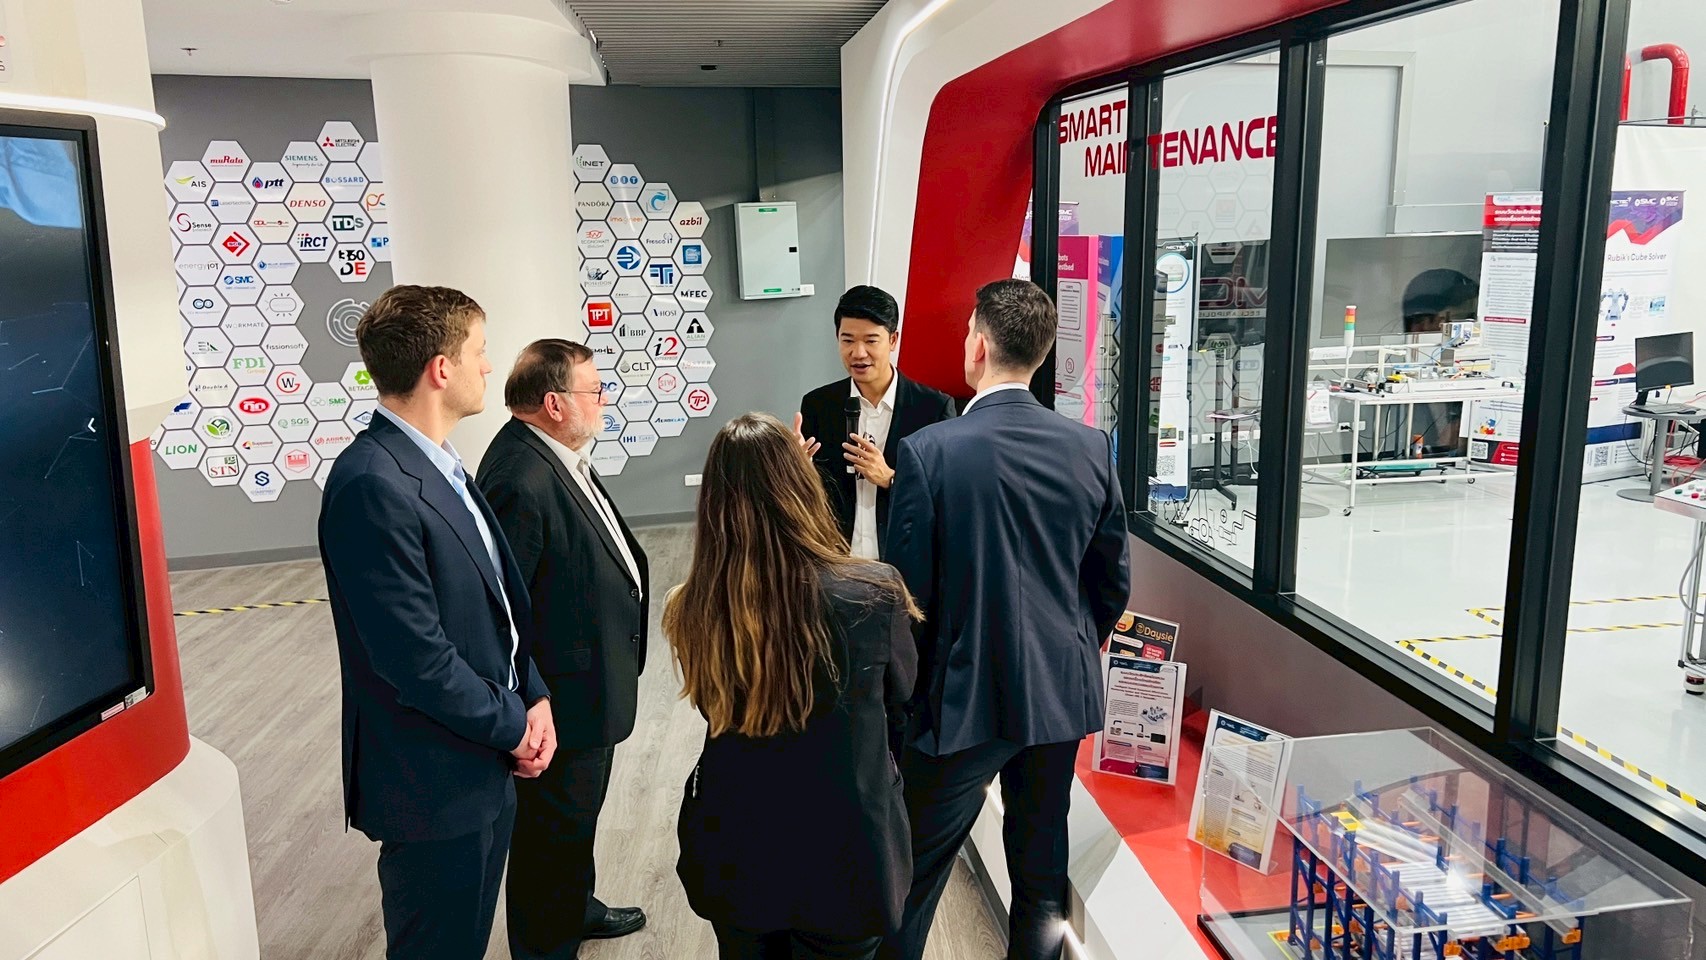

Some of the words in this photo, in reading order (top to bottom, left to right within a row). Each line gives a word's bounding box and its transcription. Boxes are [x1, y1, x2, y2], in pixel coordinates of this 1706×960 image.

[1058, 100, 1126, 144] SMART
[210, 155, 243, 164] muRata
[264, 178, 284, 188] ptt
[333, 217, 364, 229] TDS
[680, 216, 702, 225] azbil
[1631, 253, 1648, 261] Cube
[1649, 252, 1667, 260] Solver
[235, 275, 254, 284] SMC
[232, 357, 266, 369] FDI
[632, 362, 650, 371] CLT
[623, 435, 636, 443] IHI
[165, 444, 197, 455] LION
[210, 465, 237, 476] STN
[1144, 626, 1174, 642] Daysie
